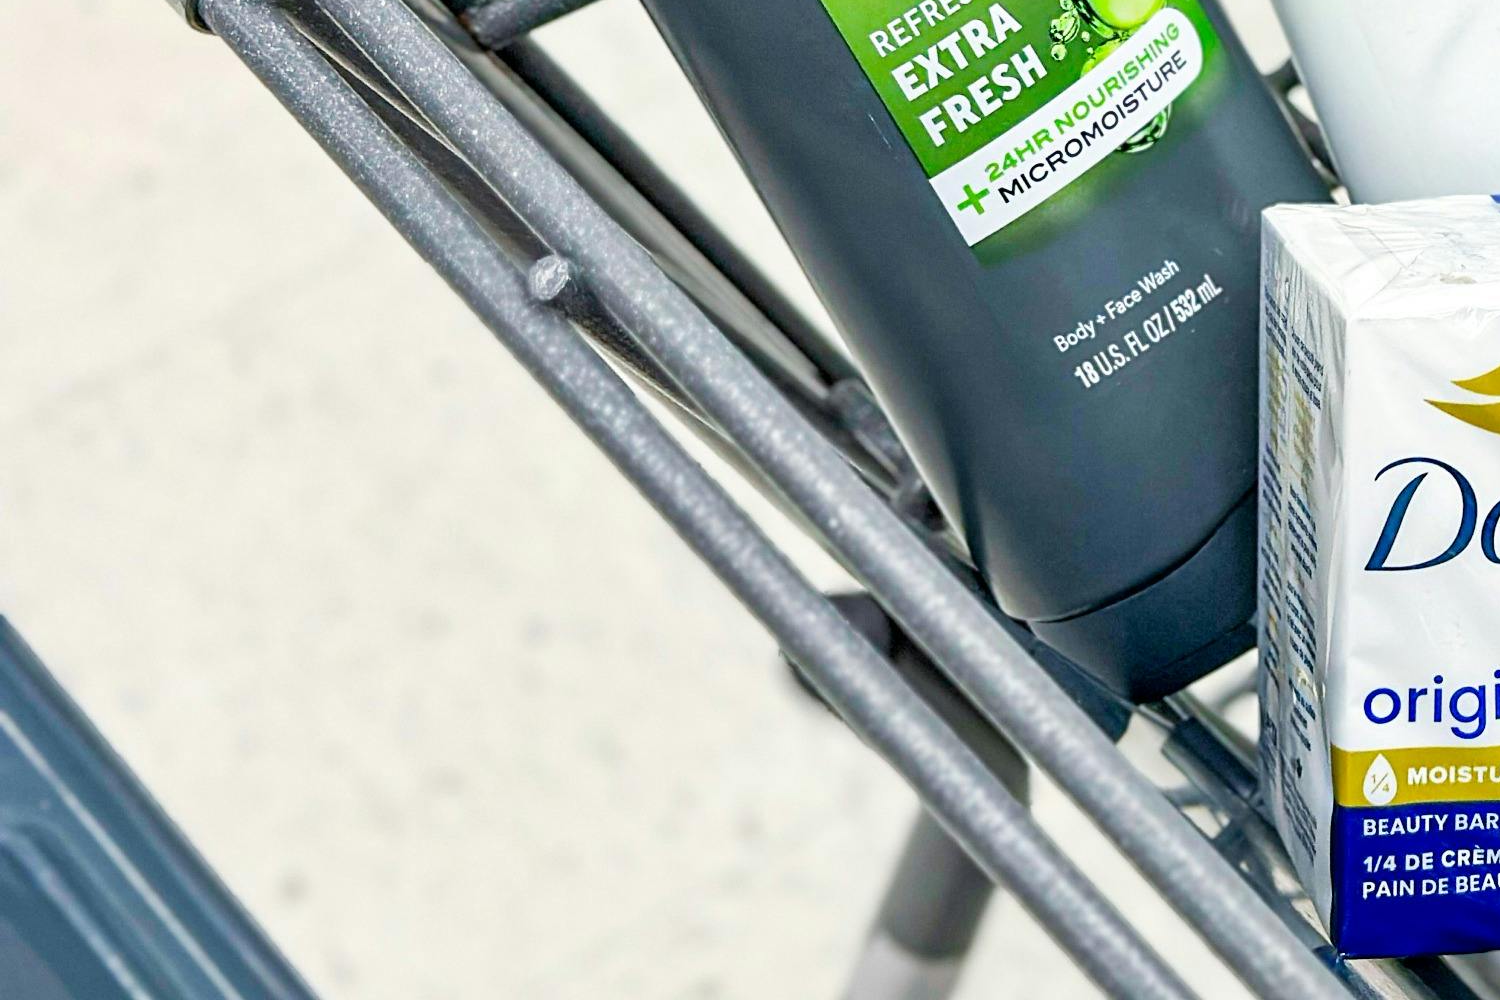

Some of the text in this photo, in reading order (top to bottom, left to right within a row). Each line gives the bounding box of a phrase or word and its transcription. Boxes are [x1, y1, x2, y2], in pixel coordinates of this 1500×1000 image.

[891, 2, 1023, 103] EXTRA
[918, 43, 1048, 148] FRESH
[985, 128, 1055, 182] 24HR
[1054, 22, 1181, 134] NOURISHING
[998, 50, 1188, 204] MICROMOISTURE
[1053, 322, 1096, 352] Body
[1104, 289, 1143, 320] Face
[1137, 259, 1180, 294] Wash
[1074, 361, 1101, 388] 18
[1093, 344, 1131, 376] U.S.
[1124, 330, 1150, 357] FL
[1196, 273, 1224, 304] mL
[1363, 814, 1447, 837] BEAUTY
[1454, 813, 1499, 832] BAR
[1363, 854, 1398, 874] 1/4
[1405, 852, 1434, 871] DE
[1362, 879, 1415, 899] PAIN
[1421, 877, 1449, 896] DE
